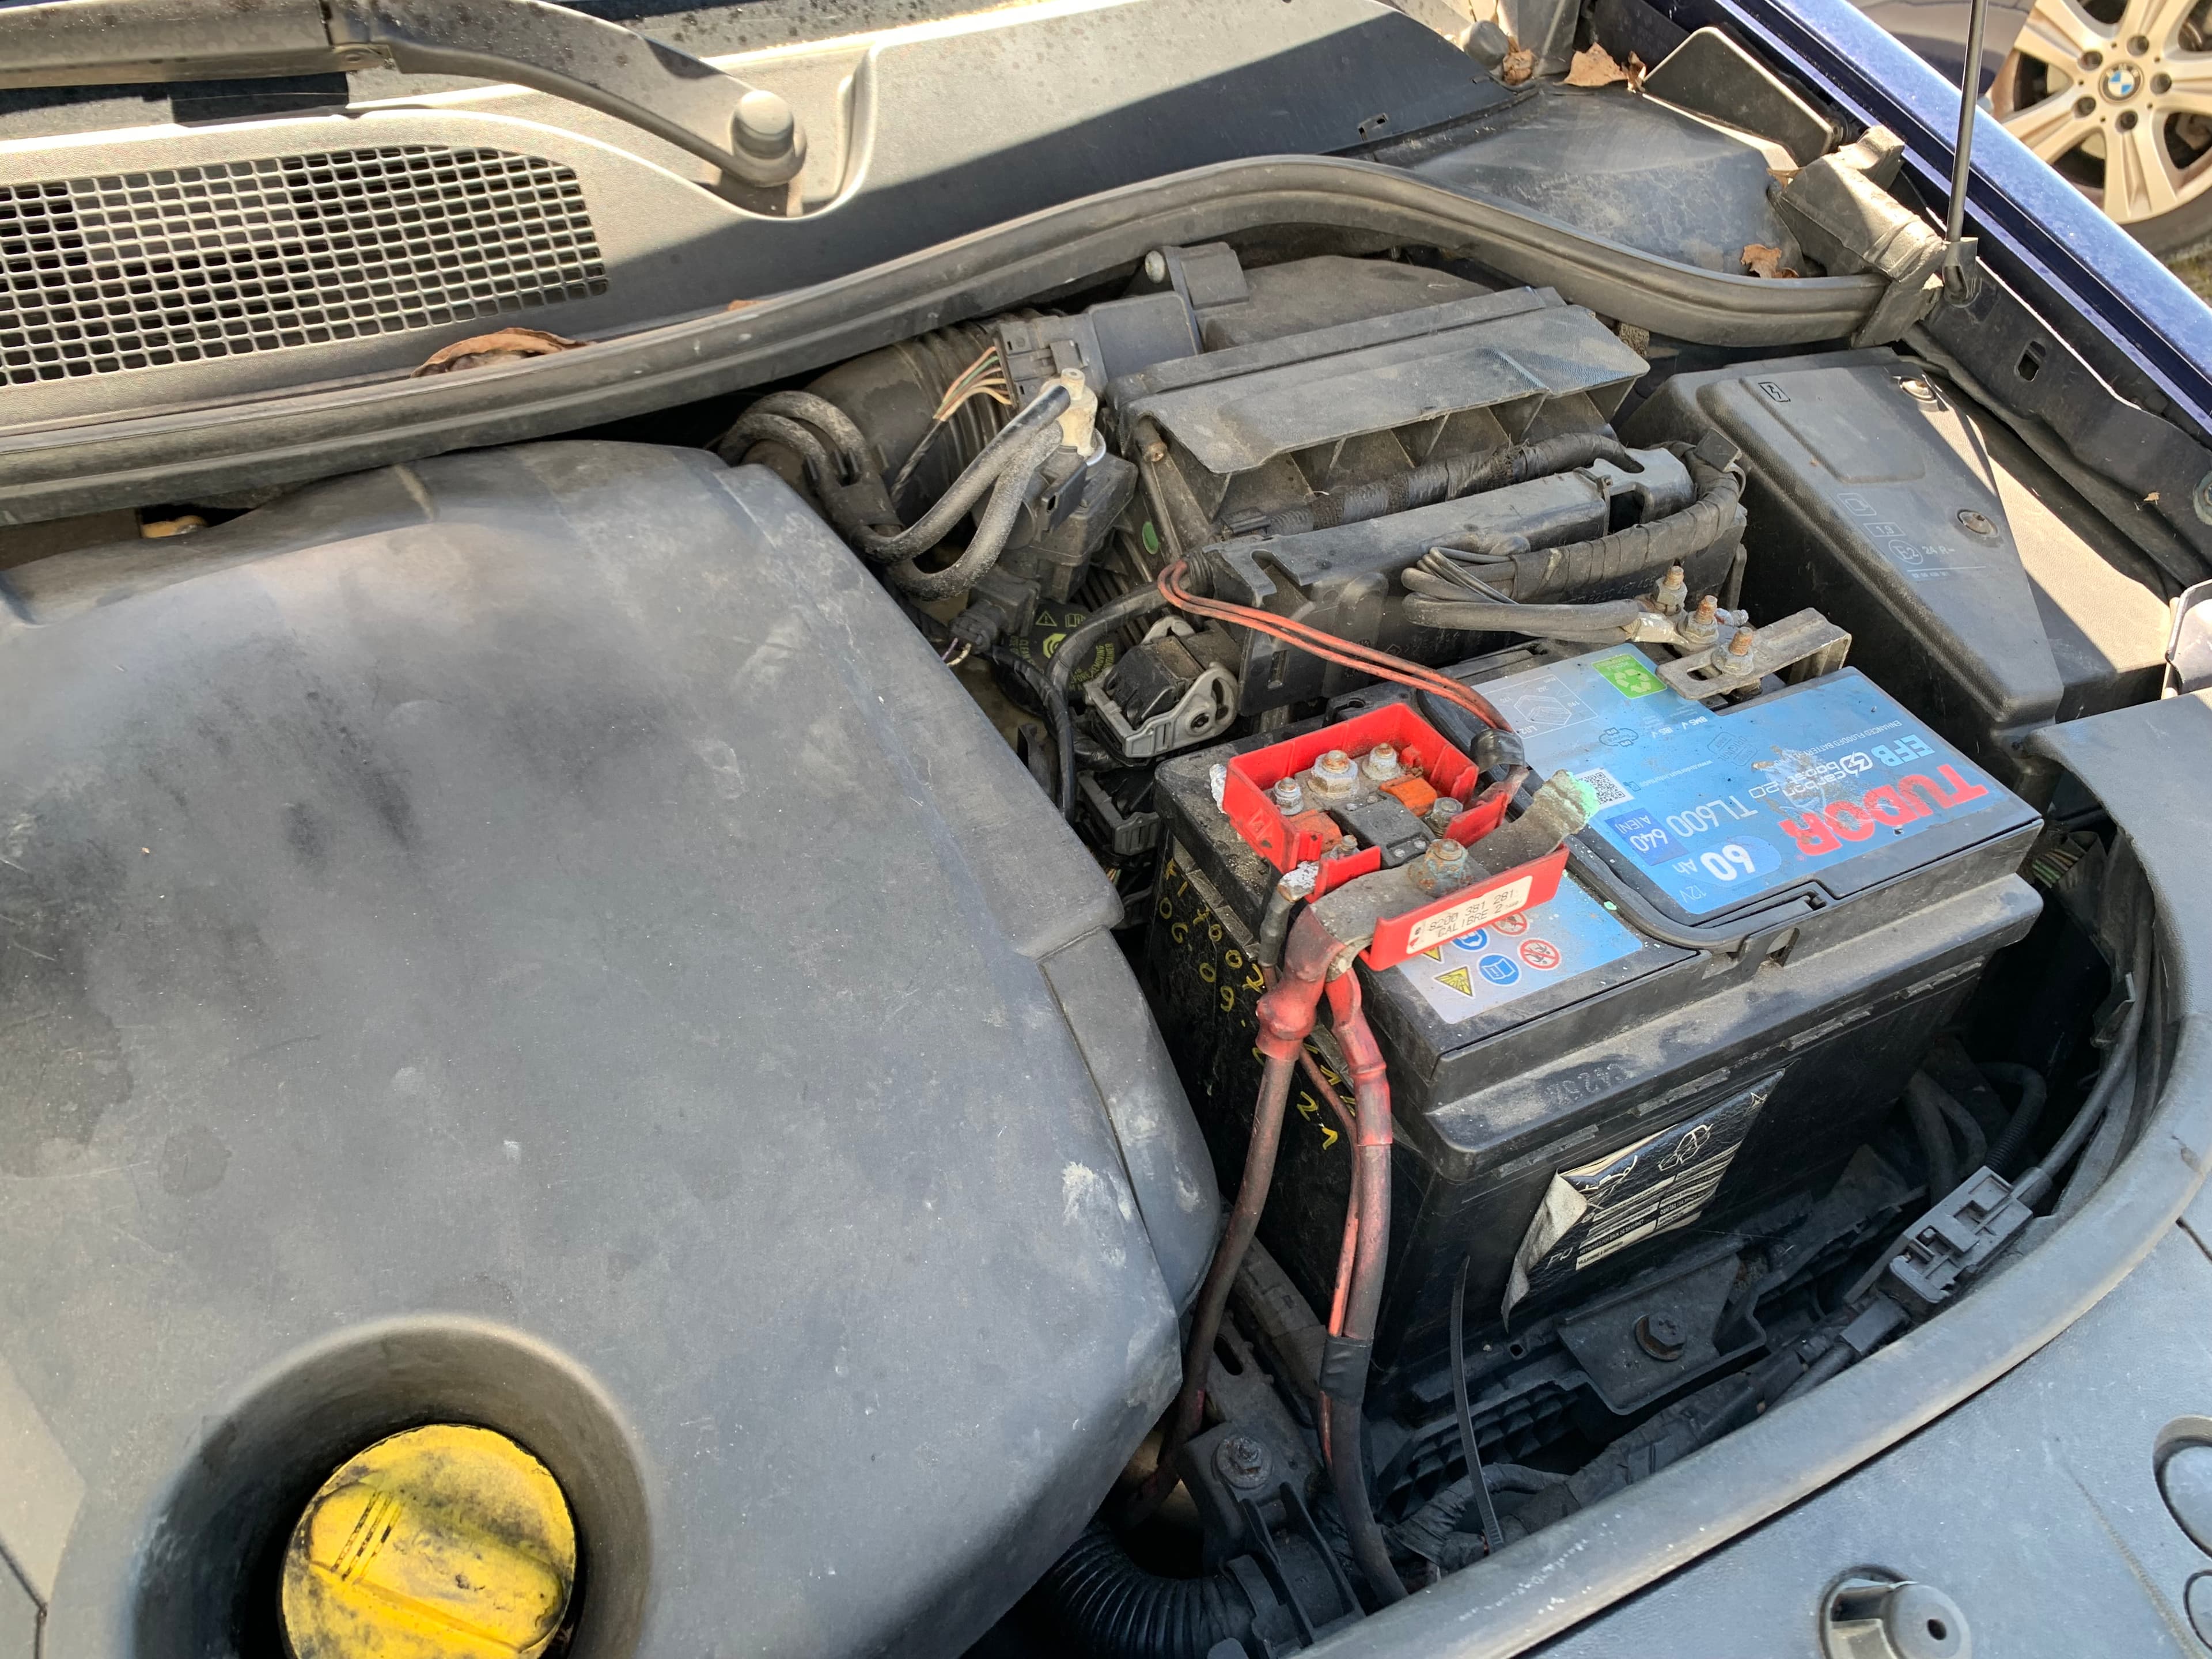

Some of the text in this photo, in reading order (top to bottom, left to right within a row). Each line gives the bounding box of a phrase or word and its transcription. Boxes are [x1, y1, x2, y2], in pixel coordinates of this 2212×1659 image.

[1892, 545, 1919, 561] E2
[1690, 715, 1709, 726] BMS
[1802, 719, 1903, 756] ENHANCED FLOODED BATTERY
[1870, 734, 1936, 767] EFB
[1782, 768, 1847, 798] carbon
[1786, 760, 1842, 785] boost
[1748, 781, 1780, 800] 2.0
[1666, 795, 1759, 838] TL600
[1778, 763, 1988, 856] TUDOR
[1629, 828, 1669, 852] 640
[1672, 844, 1756, 881] 60 Ah
[1465, 900, 1486, 917] 381
[1493, 889, 1514, 905] 281
[1679, 884, 1707, 903] 12V
[1494, 903, 1503, 914] 2
